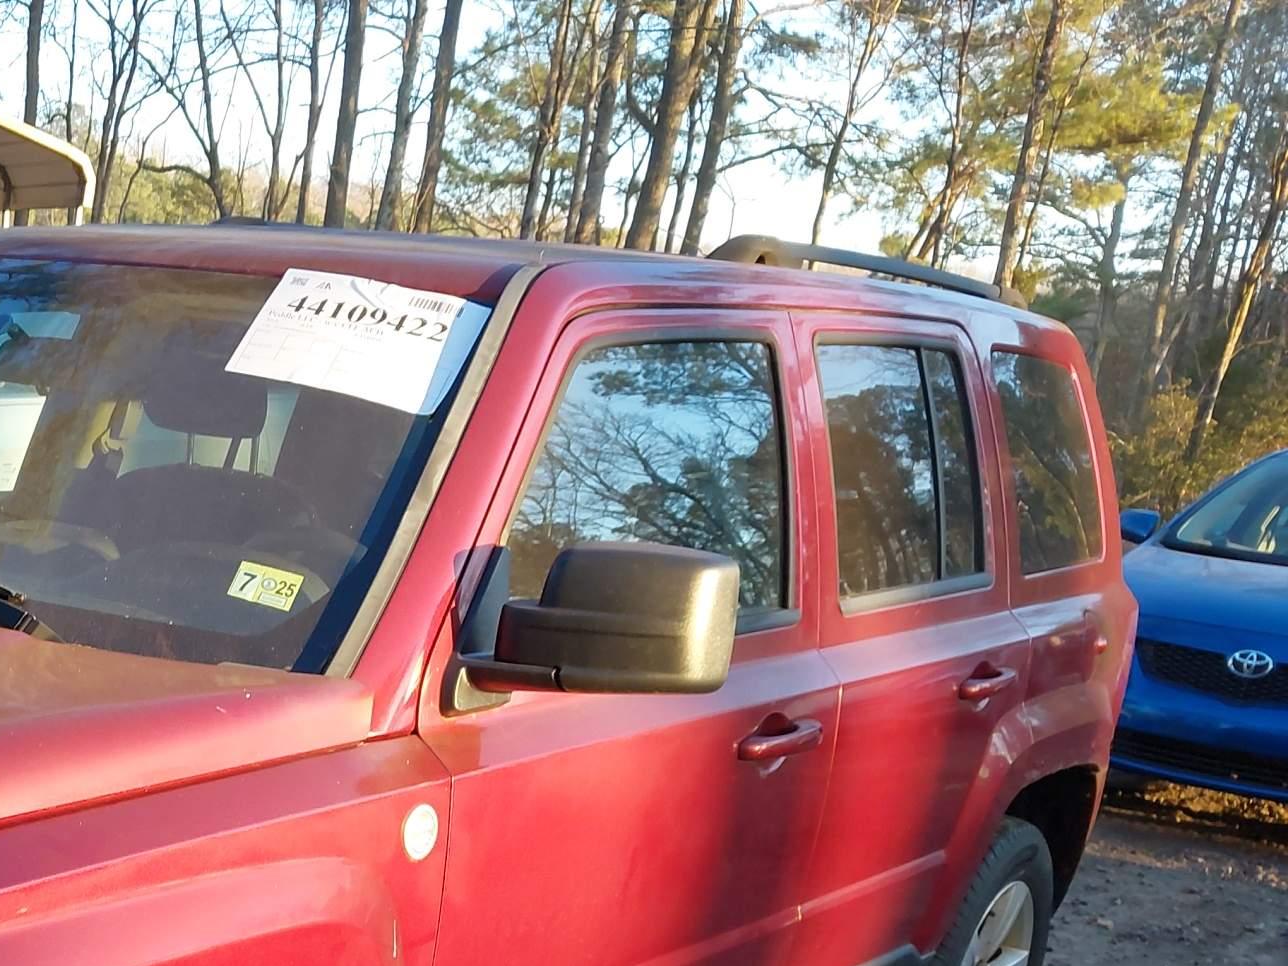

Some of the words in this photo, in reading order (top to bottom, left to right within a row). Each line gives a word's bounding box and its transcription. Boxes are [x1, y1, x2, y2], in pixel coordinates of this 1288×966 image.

[287, 295, 448, 342] 44109422
[239, 572, 257, 591] 7
[275, 580, 297, 598] 25
